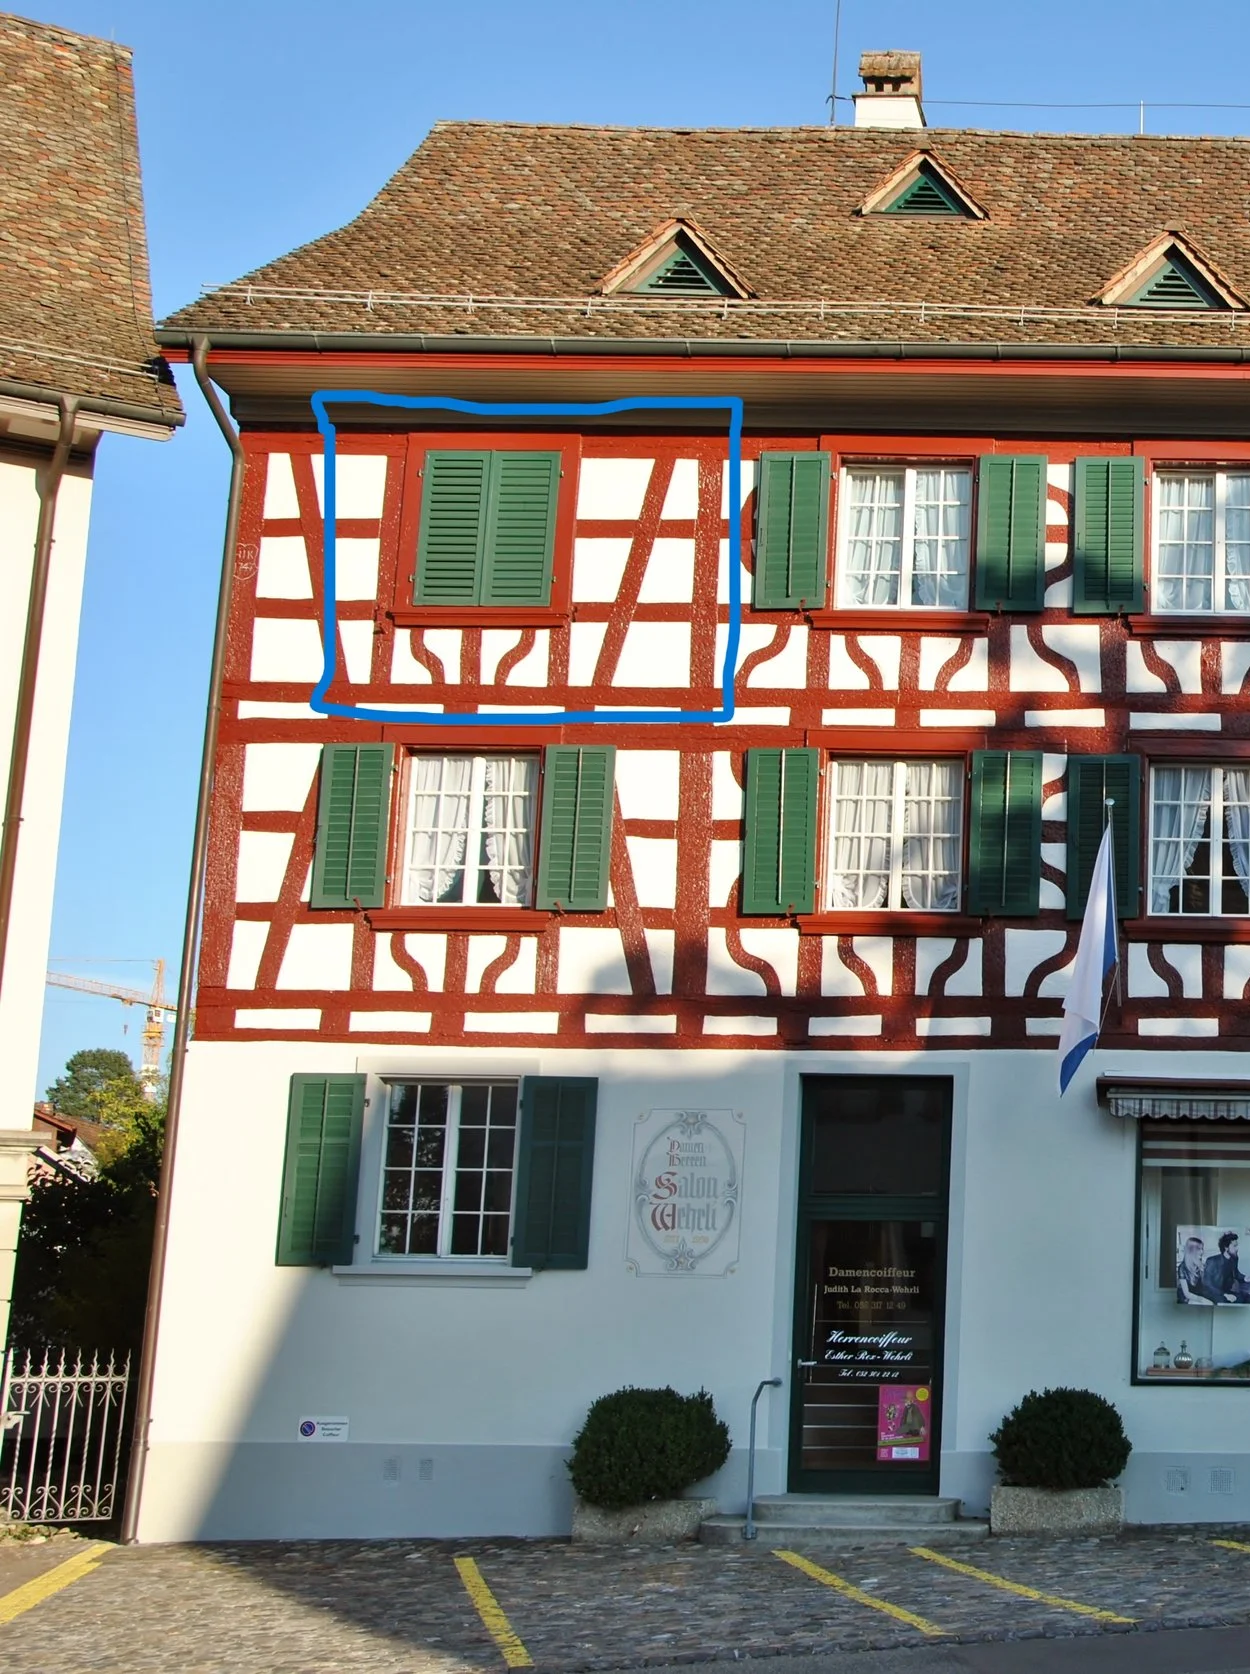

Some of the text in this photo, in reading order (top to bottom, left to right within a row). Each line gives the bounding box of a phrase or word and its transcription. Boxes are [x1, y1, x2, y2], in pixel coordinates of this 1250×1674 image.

[651, 1171, 720, 1200] Salon
[649, 1201, 718, 1233] Wehrli
[828, 1266, 916, 1278] Damencoiffeur
[824, 1285, 849, 1294] Judith
[851, 1285, 861, 1293] La
[836, 1301, 852, 1310] Tel.
[826, 1330, 912, 1348] Herrencoiffeur
[824, 1349, 854, 1360] Esther
[838, 1368, 853, 1378] Tel.
